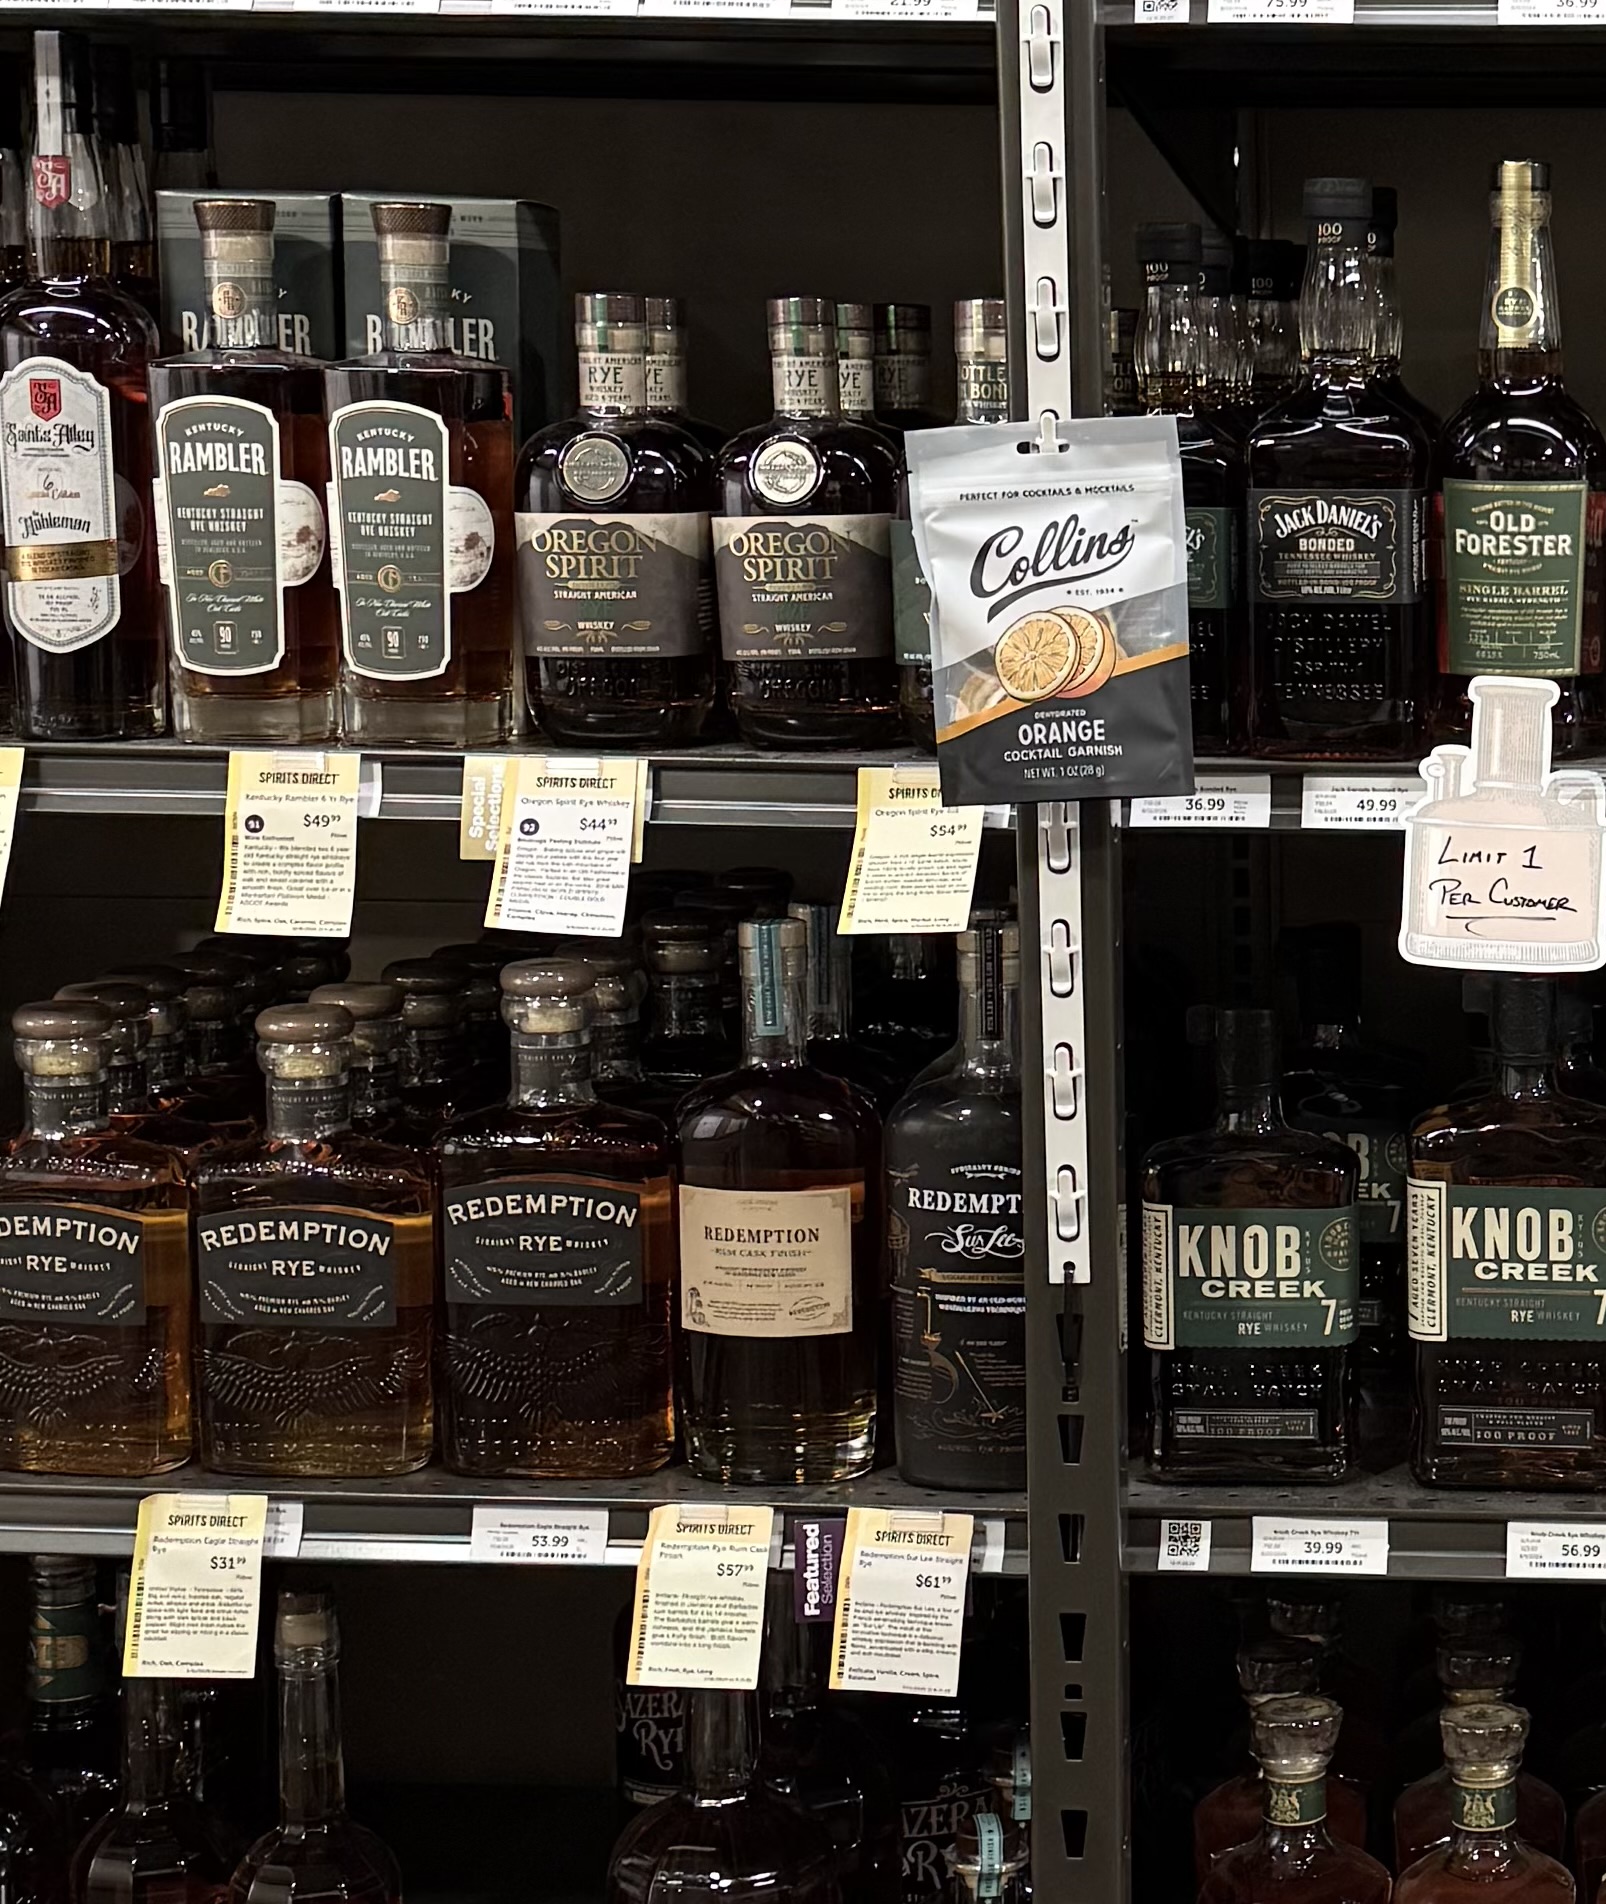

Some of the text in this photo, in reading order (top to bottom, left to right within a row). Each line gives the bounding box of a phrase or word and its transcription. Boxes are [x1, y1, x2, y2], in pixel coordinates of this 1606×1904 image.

[184, 422, 245, 437] KENTUCKY
[169, 440, 267, 479] RAMBLER
[959, 491, 999, 502] PERFECT
[1001, 490, 1018, 500] FOR
[1023, 486, 1072, 500] COCKTAILS
[1085, 483, 1134, 495] MOCKTAILS
[1275, 500, 1384, 541] JACK DANIEL'S
[1489, 512, 1536, 534] OLD
[532, 529, 657, 554] OREGON
[1299, 539, 1354, 551] BONDED
[1455, 531, 1574, 557] FORESTER
[970, 513, 1134, 599] Collins
[546, 555, 643, 581] SPIRIT
[1018, 720, 1106, 745] ORANGE
[1004, 745, 1123, 763] COCKTAIL GARNISH
[259, 772, 337, 786] SPIRITS DIRECT
[1185, 798, 1225, 812] 36.99
[1522, 845, 1543, 869] 1
[201, 1221, 390, 1256] REDEMPTION
[704, 1225, 820, 1245] REDEMPTION
[531, 1534, 569, 1548] 53.99
[1303, 1541, 1342, 1555] 39.99
[803, 1523, 819, 1617] Featured
